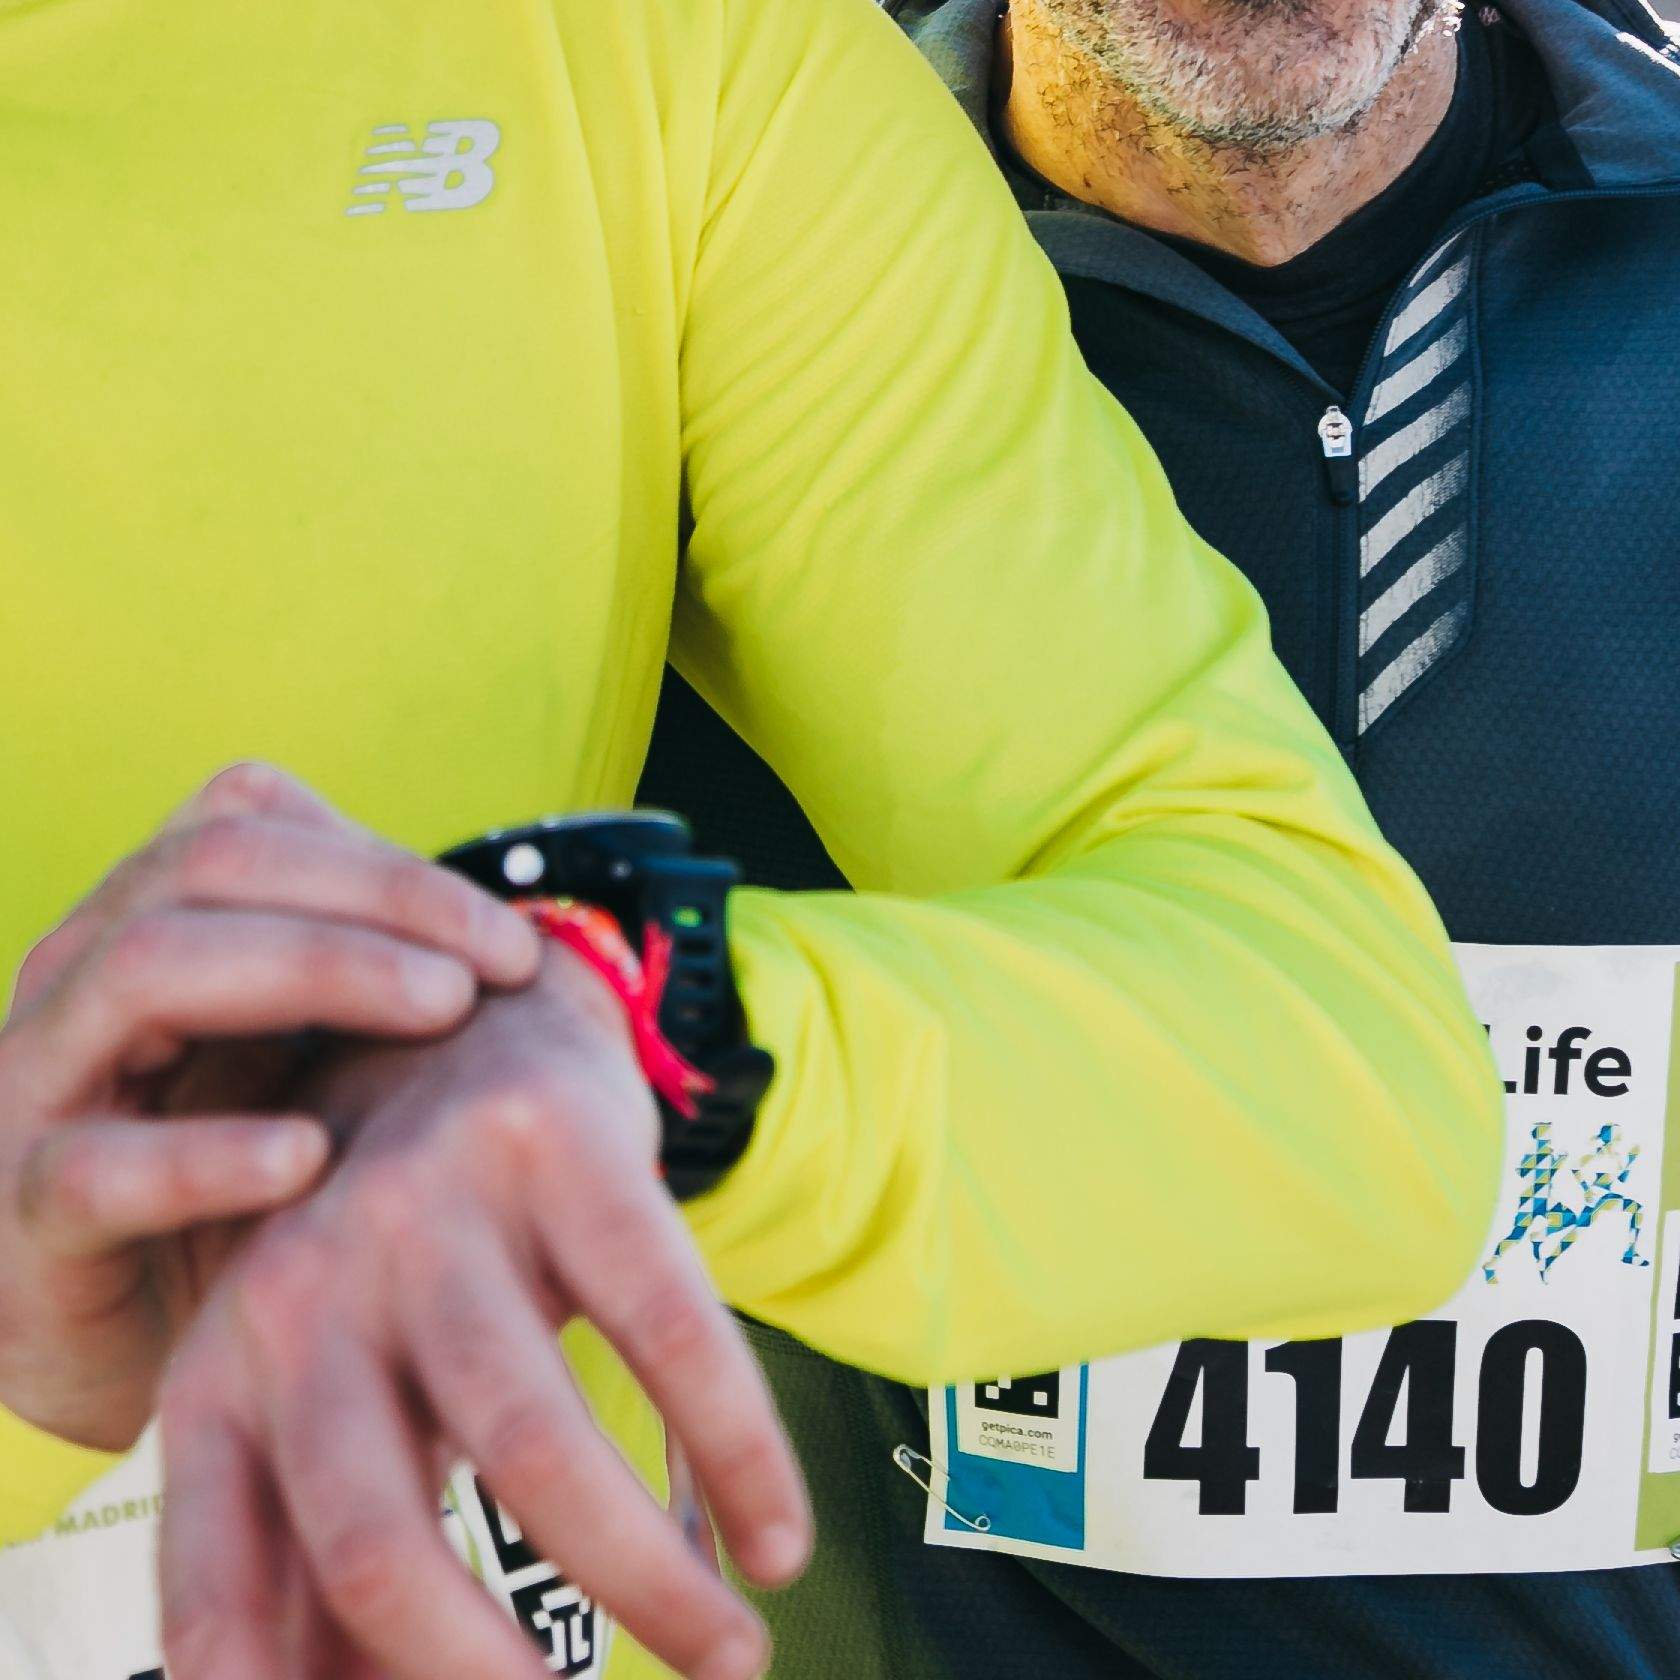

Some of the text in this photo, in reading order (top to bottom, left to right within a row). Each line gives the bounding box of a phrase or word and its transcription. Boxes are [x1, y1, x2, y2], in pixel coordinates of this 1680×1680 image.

[1481, 1024, 1632, 1098] ife
[981, 1421, 1053, 1440] getpica.com
[1143, 1319, 1587, 1516] 4140
